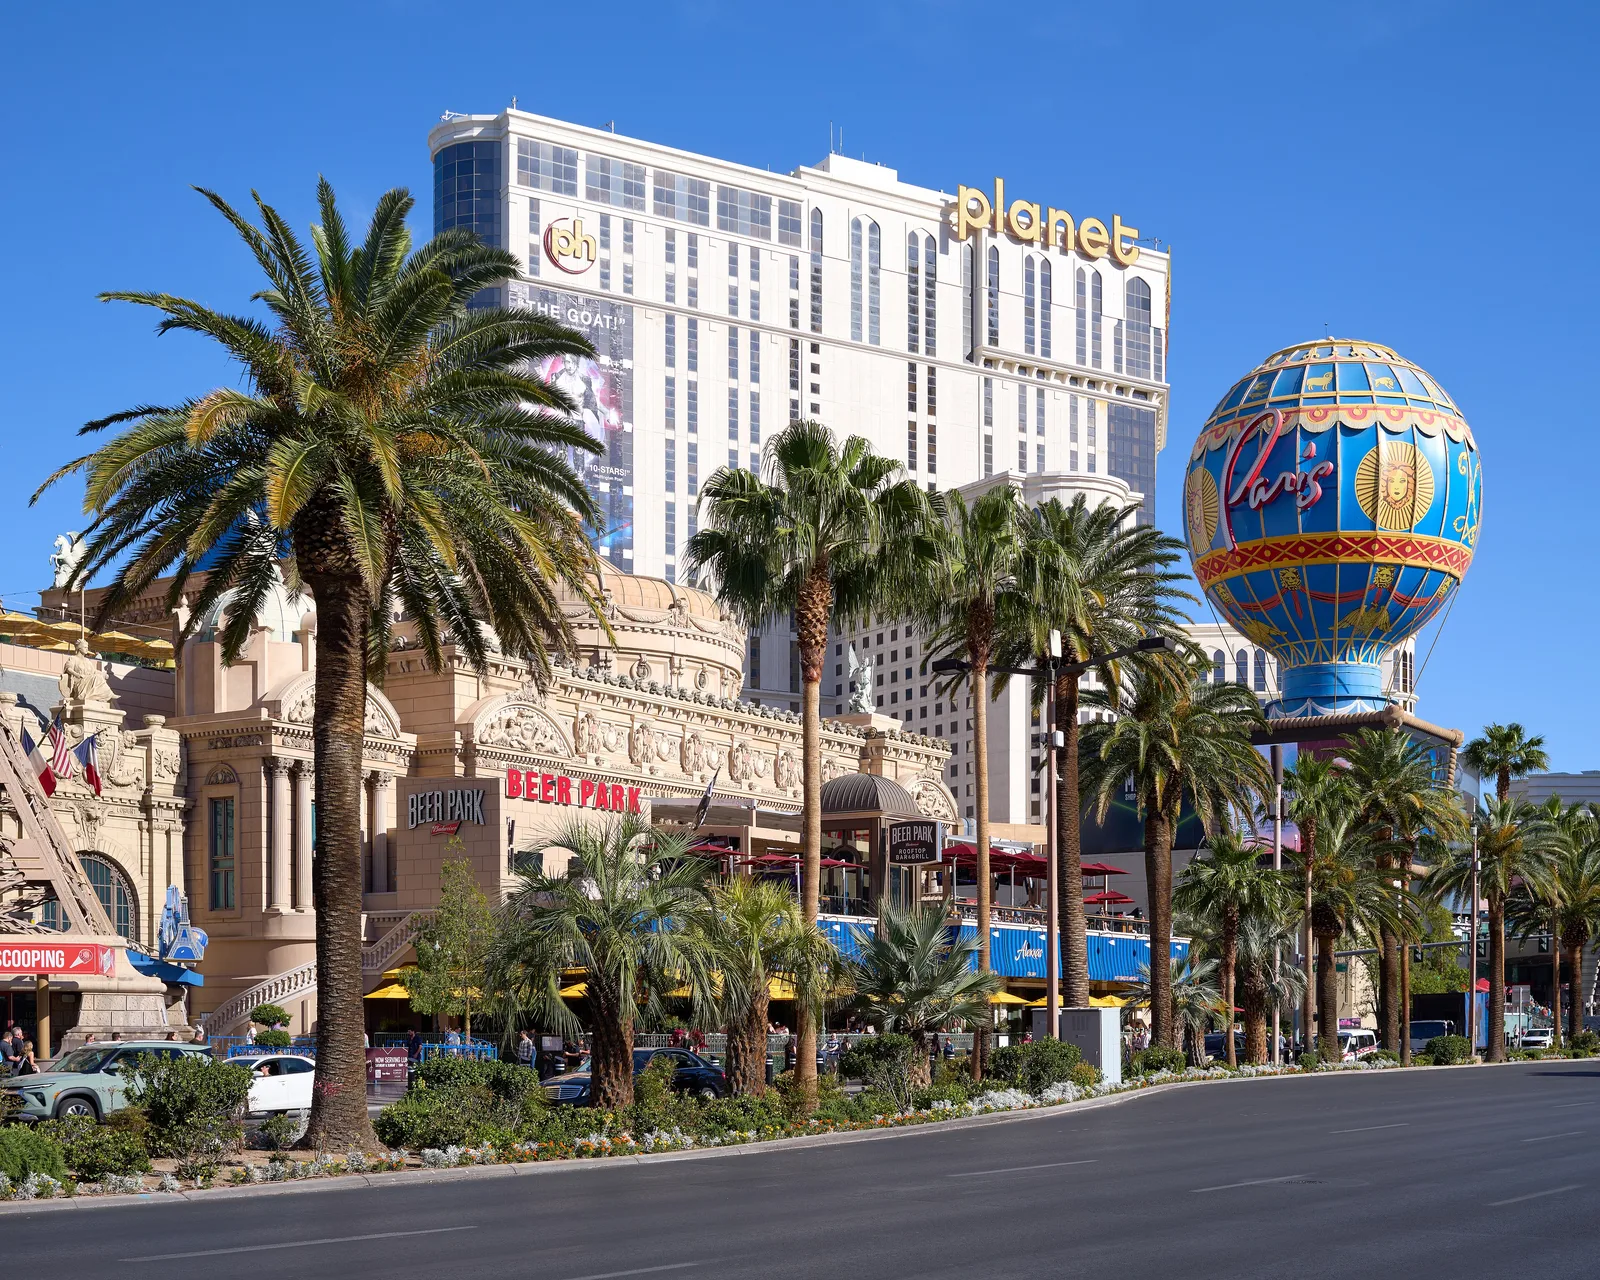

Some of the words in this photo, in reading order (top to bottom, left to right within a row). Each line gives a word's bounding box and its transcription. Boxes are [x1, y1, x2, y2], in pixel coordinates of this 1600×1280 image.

[550, 219, 596, 262] ph
[957, 177, 1140, 267] planet
[1219, 408, 1334, 552] Paris
[408, 790, 443, 830] BEER
[447, 789, 486, 826] PARK
[507, 769, 571, 804] BEER
[581, 779, 642, 814] PARK
[892, 826, 912, 845] BEER
[913, 825, 934, 843] PARK
[0, 949, 65, 968] COOPING
